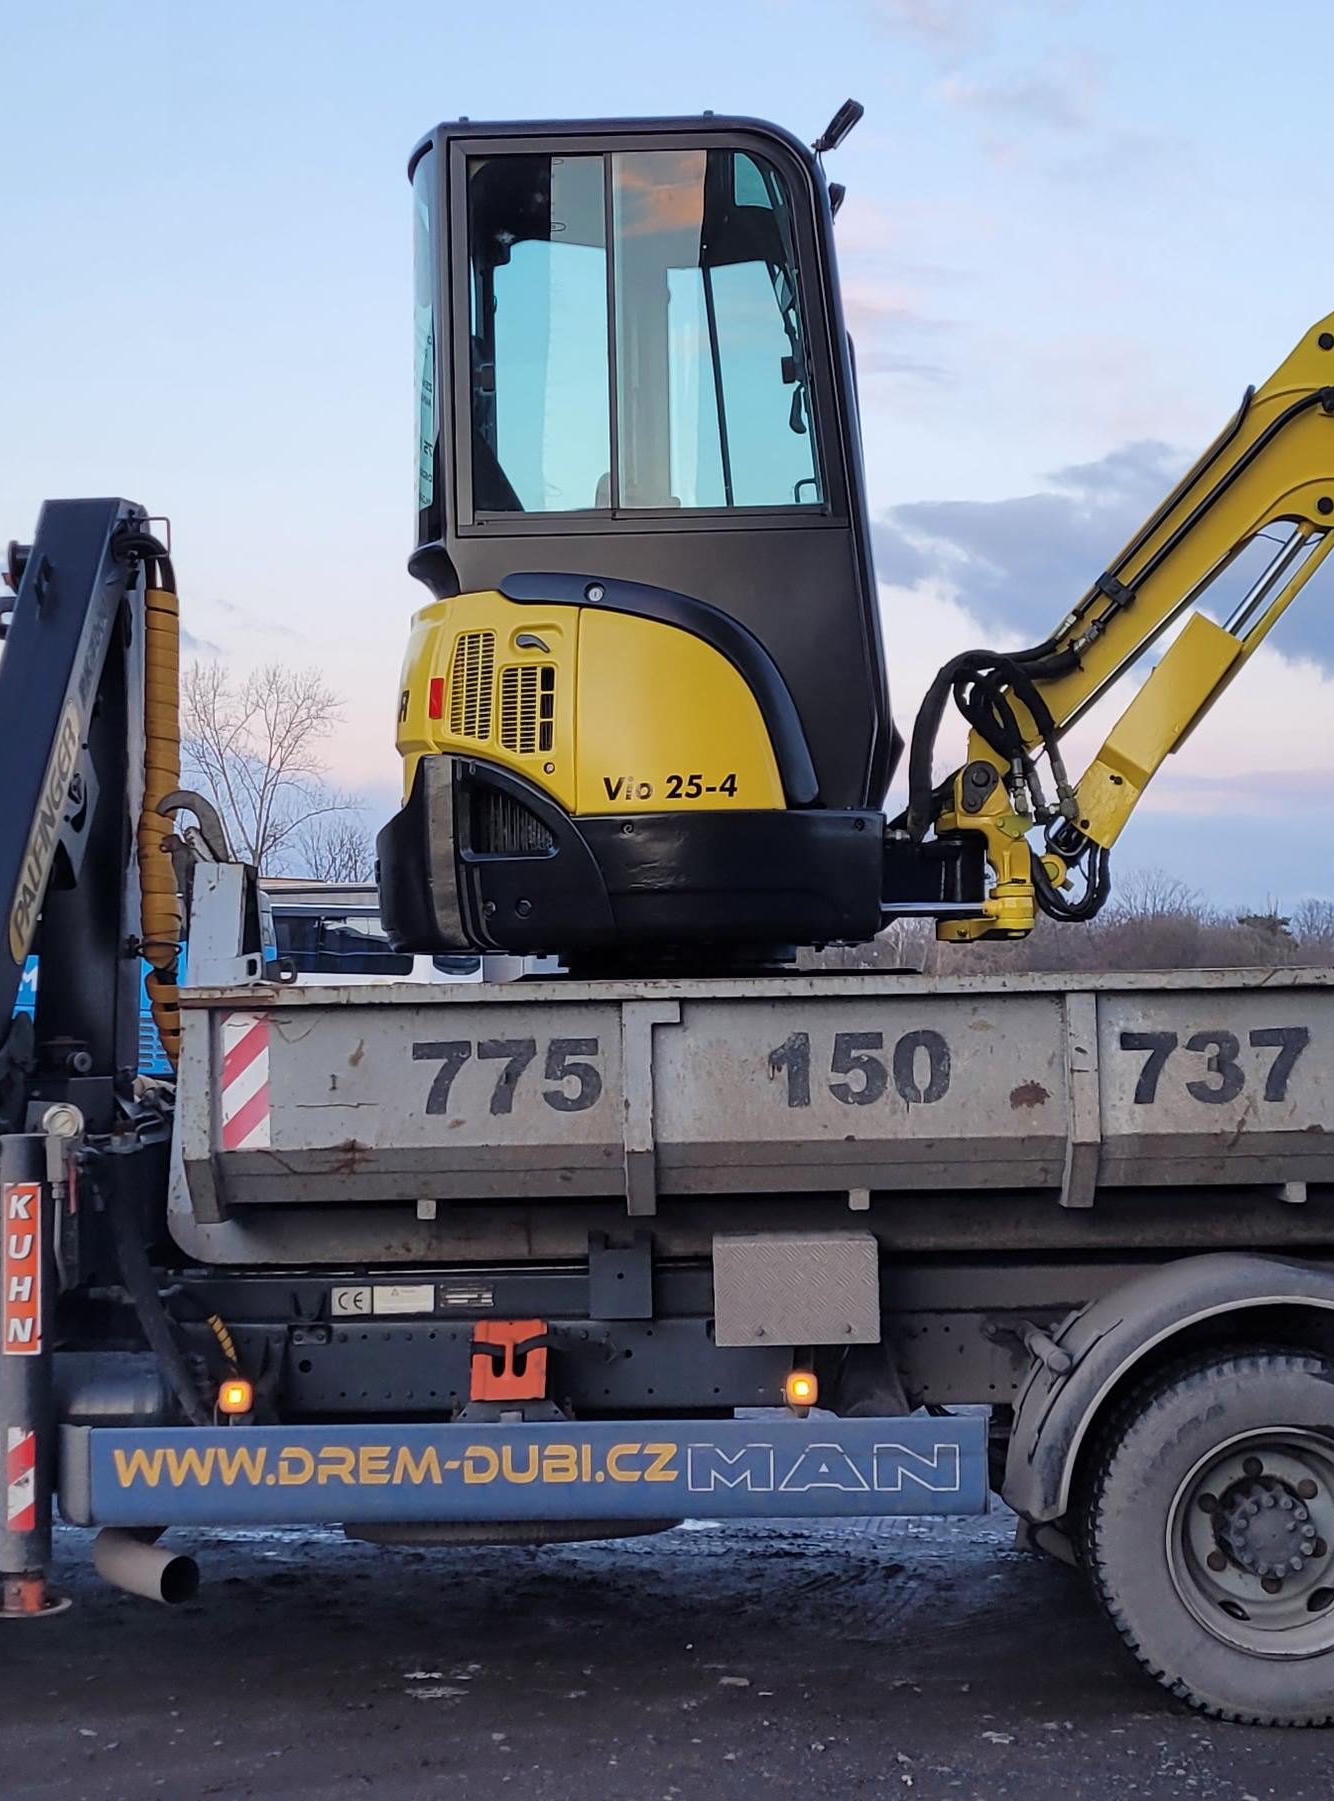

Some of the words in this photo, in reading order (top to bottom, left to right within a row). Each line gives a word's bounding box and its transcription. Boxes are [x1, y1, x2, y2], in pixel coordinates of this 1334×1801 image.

[666, 773, 738, 799] 25-4
[14, 717, 75, 946] PALFINGER
[411, 1037, 603, 1116] 775
[768, 1029, 952, 1109] 150
[1119, 1026, 1311, 1106] 737
[7, 1195, 33, 1344] KUHN
[113, 1442, 679, 1489] WWW.DREM-DUBI.CZ
[686, 1442, 962, 1493] MAN
